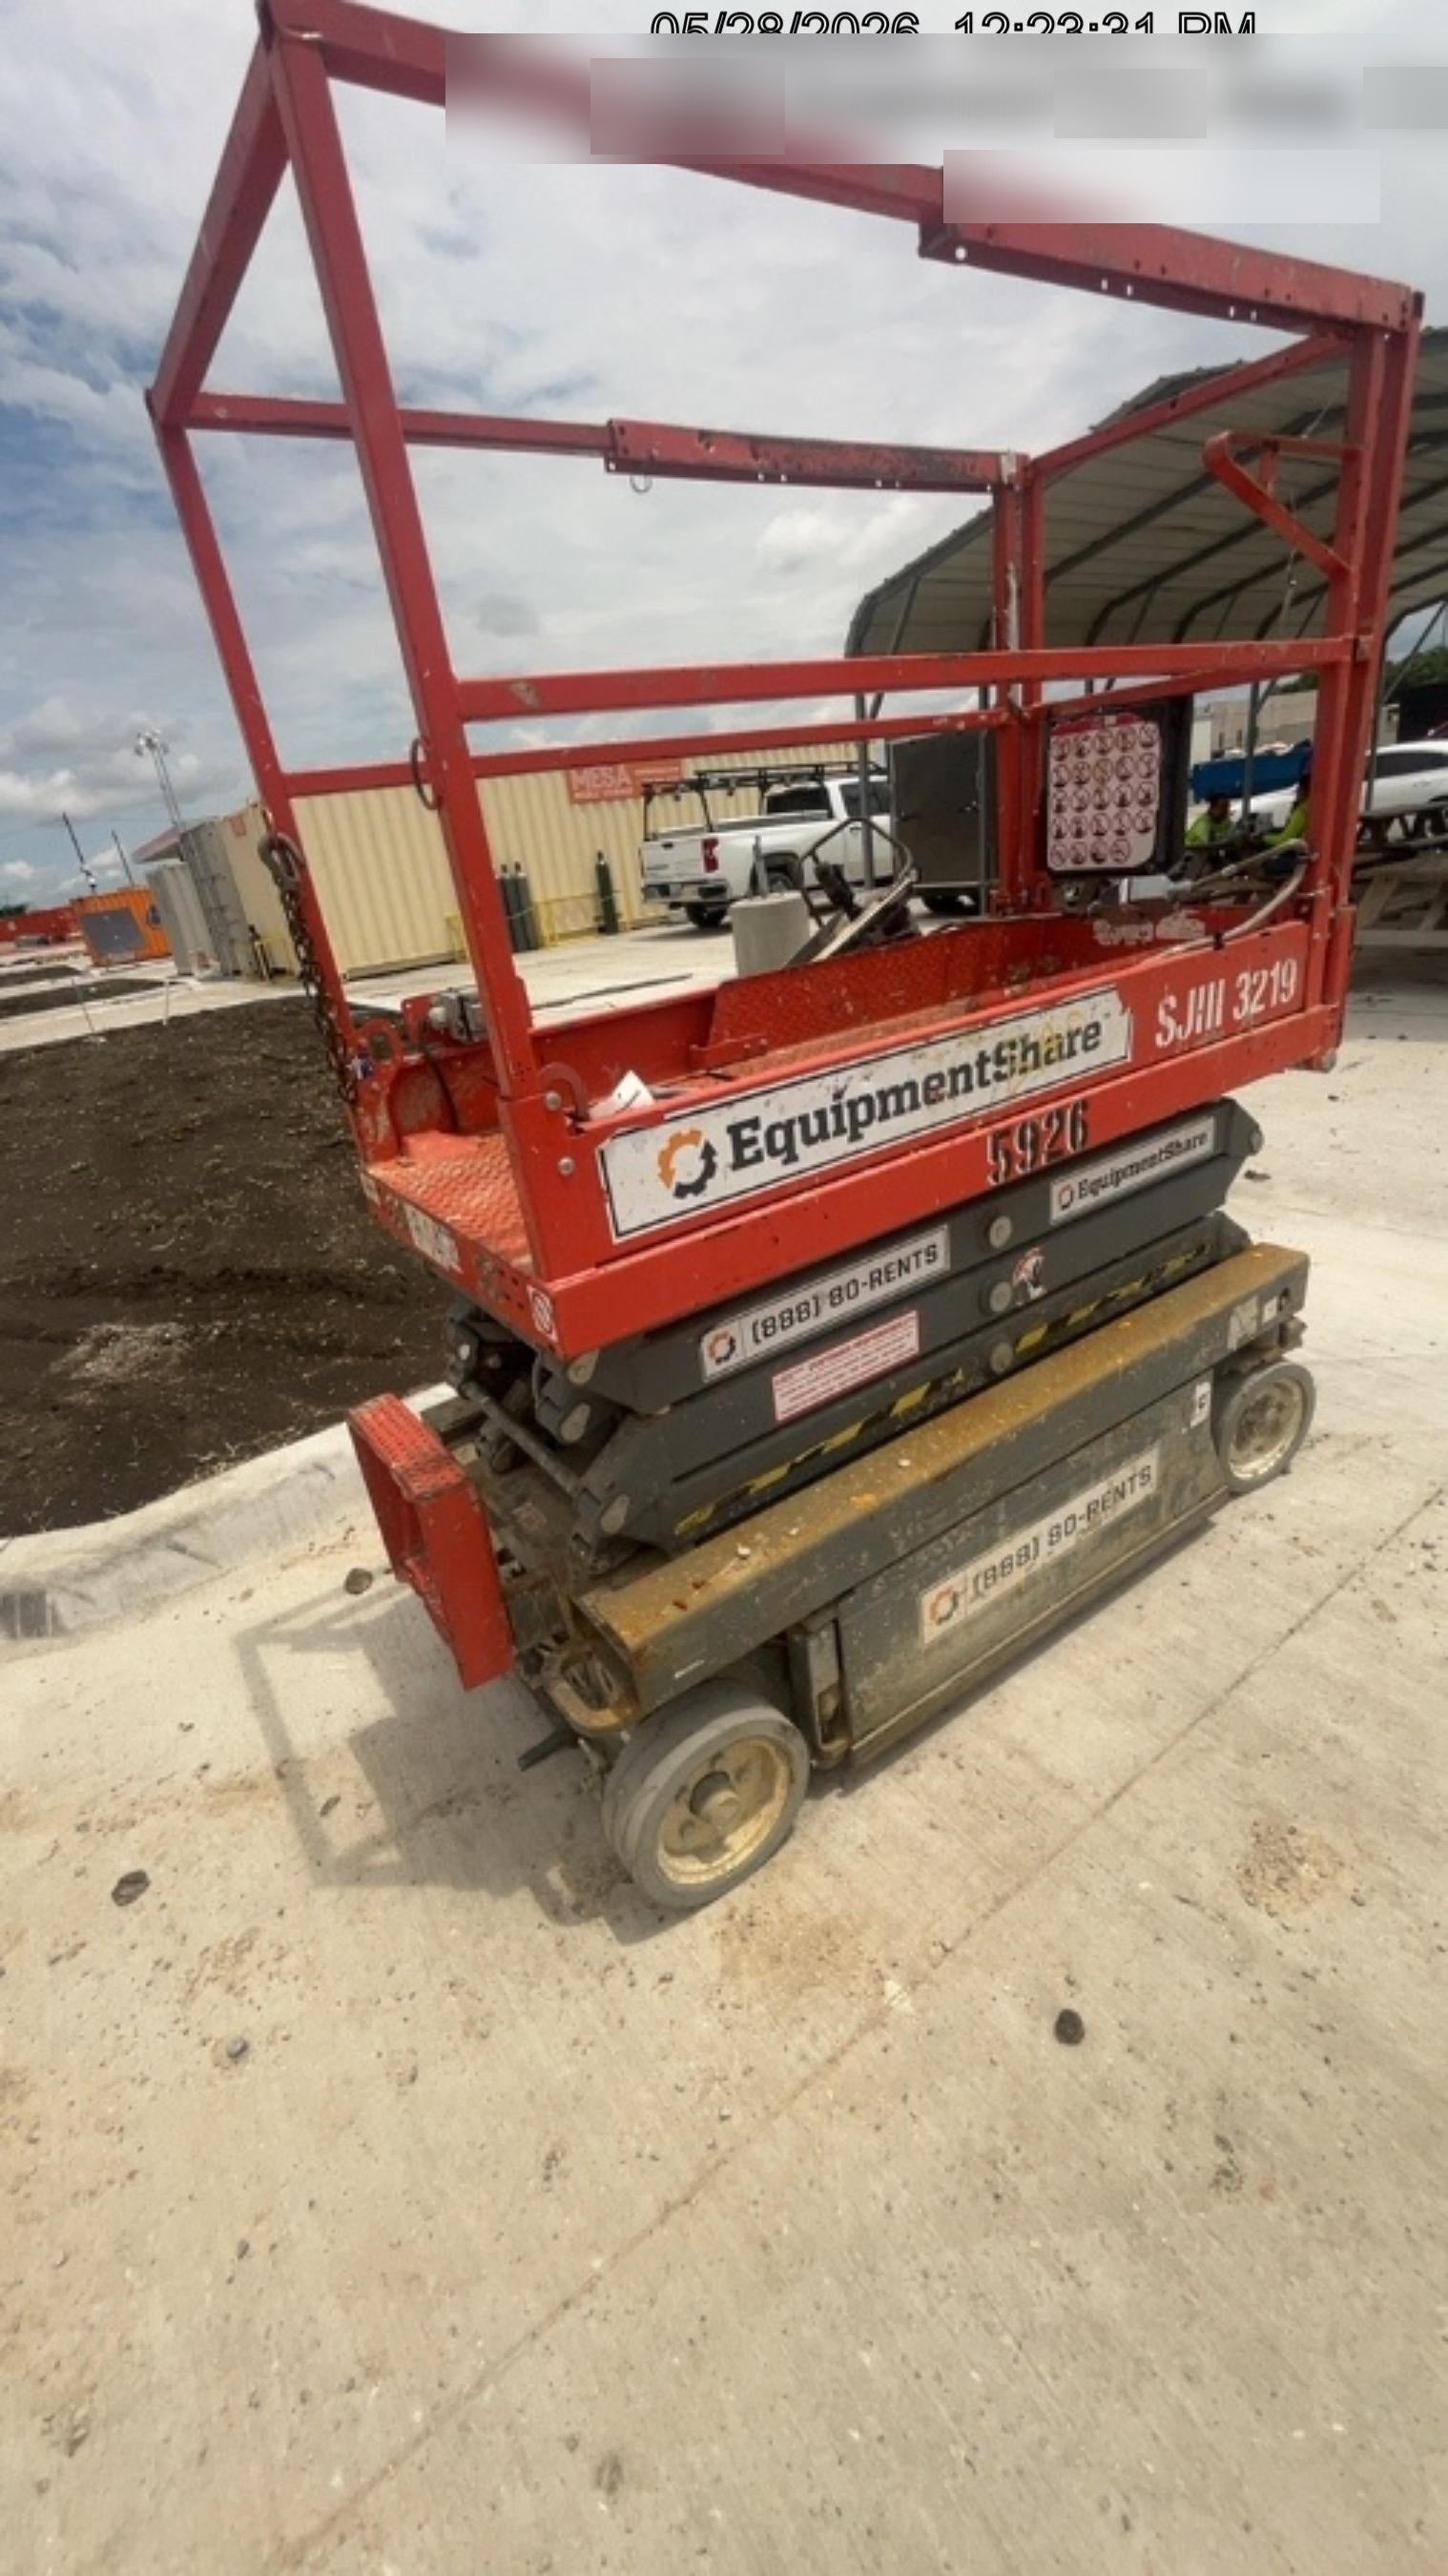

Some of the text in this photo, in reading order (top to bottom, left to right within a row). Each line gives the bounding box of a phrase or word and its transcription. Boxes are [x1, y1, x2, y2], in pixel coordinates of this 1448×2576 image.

[1232, 958, 1297, 1020] 3219
[726, 1016, 1102, 1171] EquipmentShare
[986, 1099, 1089, 1187] 5926
[1077, 1130, 1209, 1199] EquipmentShare
[751, 1243, 939, 1343] (888) 80-RENTS
[971, 1465, 1153, 1598] (888) 80-RENTS
